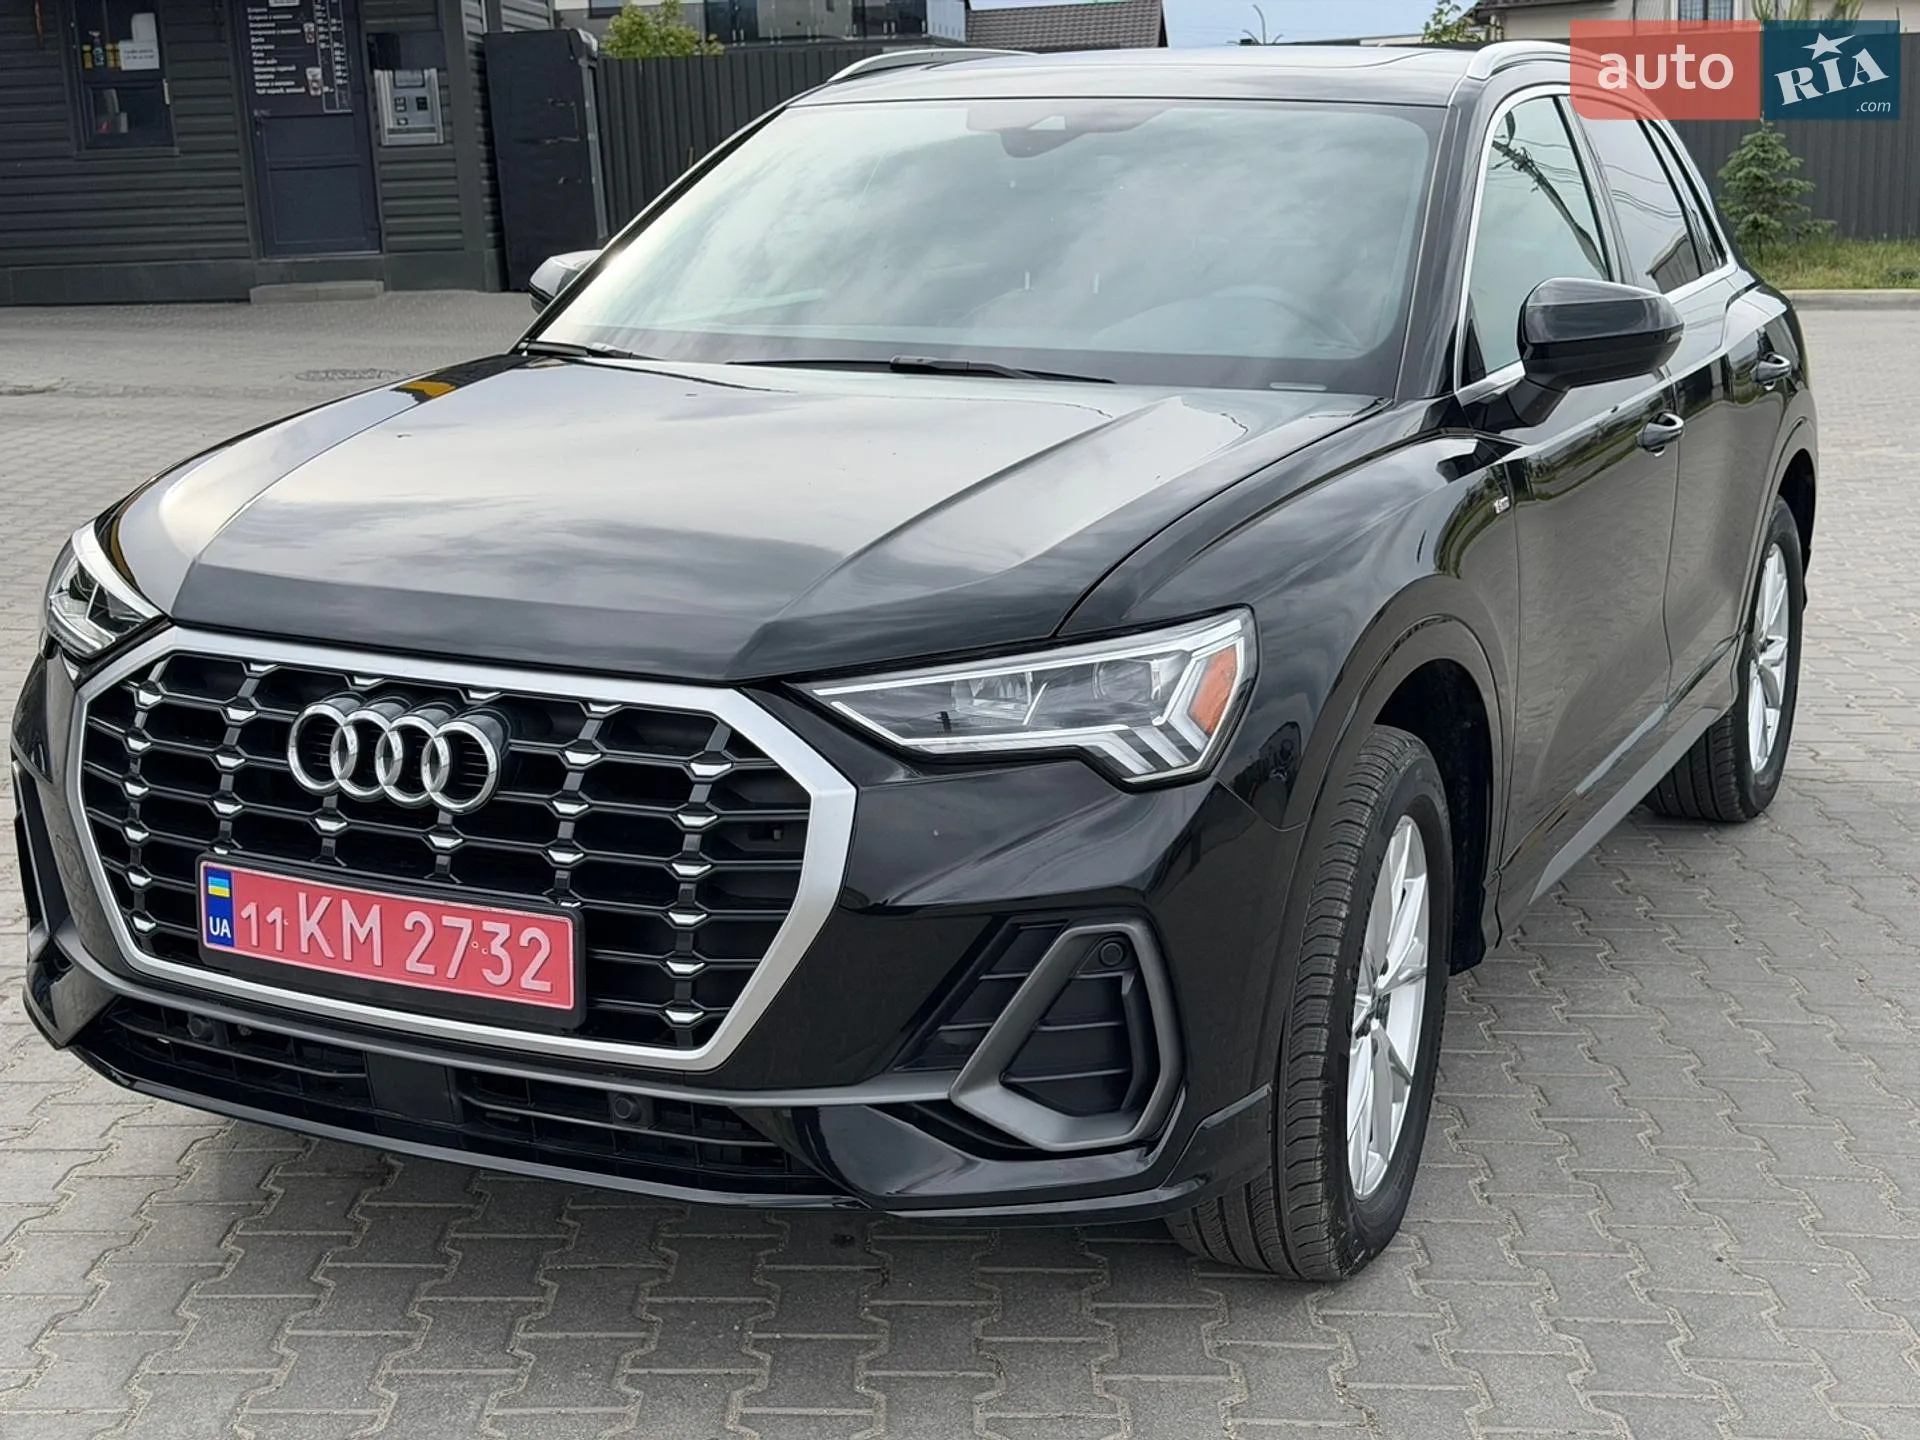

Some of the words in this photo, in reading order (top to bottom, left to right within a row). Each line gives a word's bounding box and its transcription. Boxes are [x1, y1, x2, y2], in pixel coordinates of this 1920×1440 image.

[209, 915, 232, 939] UA
[240, 901, 285, 952] 11
[298, 892, 384, 968] KM
[404, 910, 553, 993] 2732
